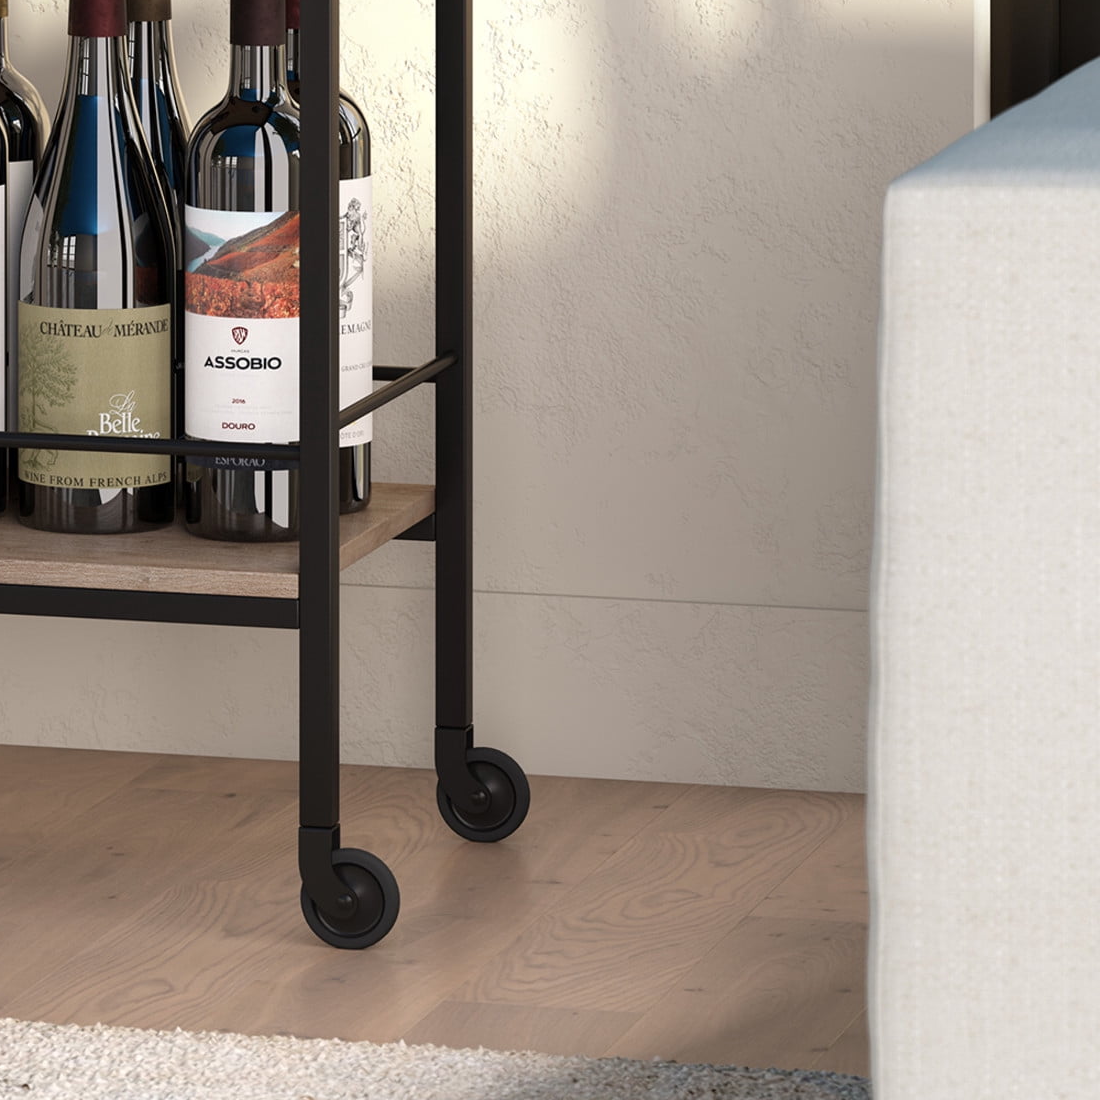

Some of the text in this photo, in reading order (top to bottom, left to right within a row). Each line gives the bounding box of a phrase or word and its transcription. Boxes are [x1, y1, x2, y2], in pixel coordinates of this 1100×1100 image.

[39, 320, 102, 338] CHÂTEAU
[113, 318, 169, 337] MÉRANDE
[204, 356, 282, 370] ASSOBIO
[109, 390, 136, 416] La
[99, 412, 141, 434] Belle
[221, 422, 256, 430] DOURO
[24, 471, 167, 488] WINE FROM FRENCH ALPS
